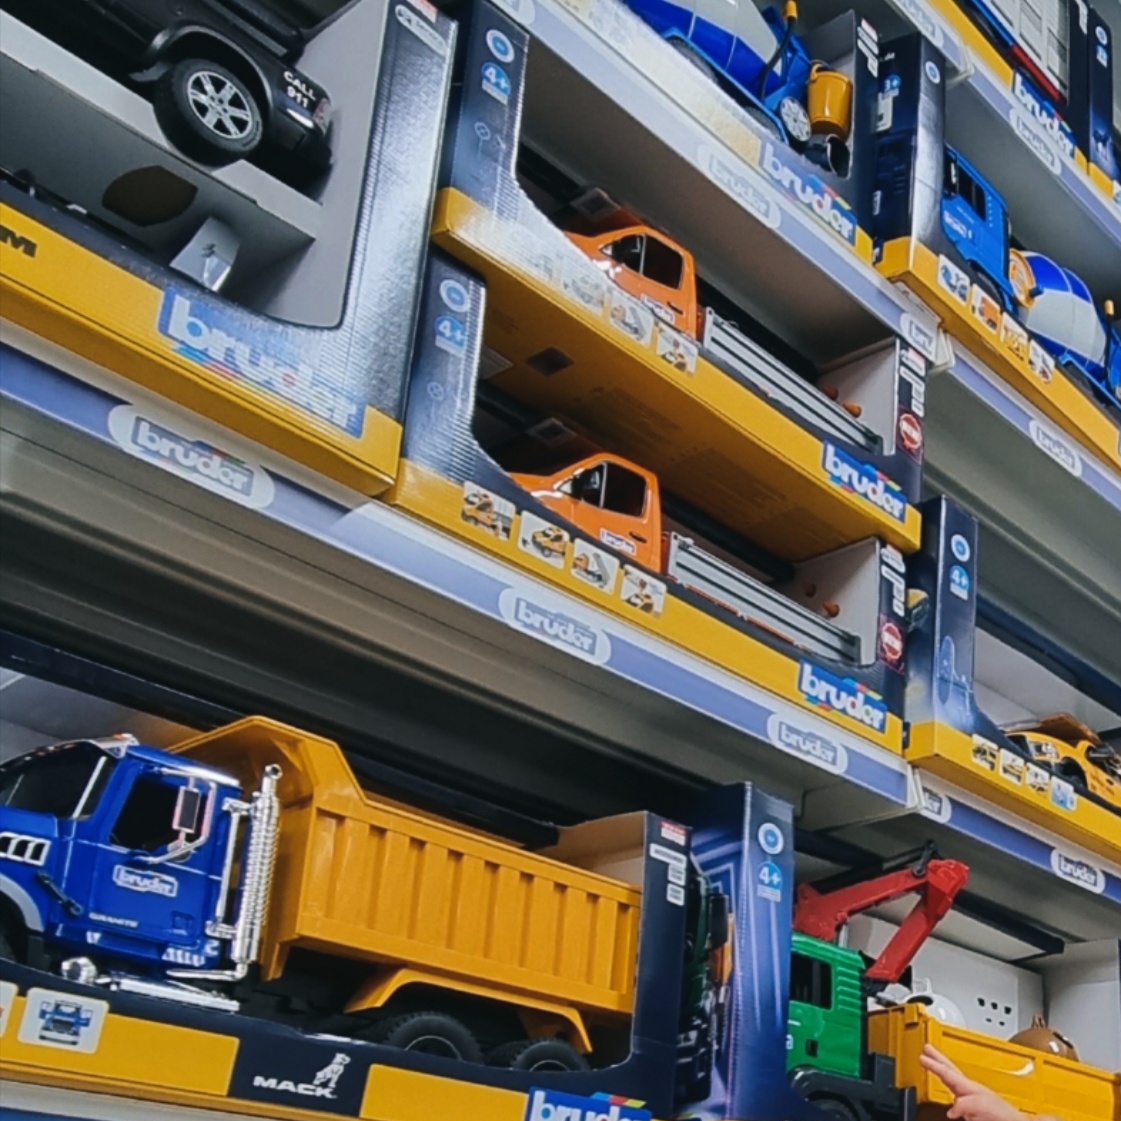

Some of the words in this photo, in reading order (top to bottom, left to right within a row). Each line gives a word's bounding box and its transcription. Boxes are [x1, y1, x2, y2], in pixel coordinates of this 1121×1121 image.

[284, 71, 316, 100] CALL
[287, 86, 309, 108] 911
[485, 67, 508, 89] 4+
[1014, 72, 1075, 151] bruder
[763, 142, 855, 237] bruder
[167, 299, 358, 425] bruder
[138, 419, 249, 488] bruder
[826, 444, 904, 518] bruder
[517, 600, 594, 651] bruder
[801, 663, 885, 729] bruder
[780, 723, 835, 763] bruder
[118, 866, 173, 892] bruder
[759, 866, 781, 885] 4+
[1060, 855, 1097, 886] bruder
[252, 1075, 334, 1098] MACK
